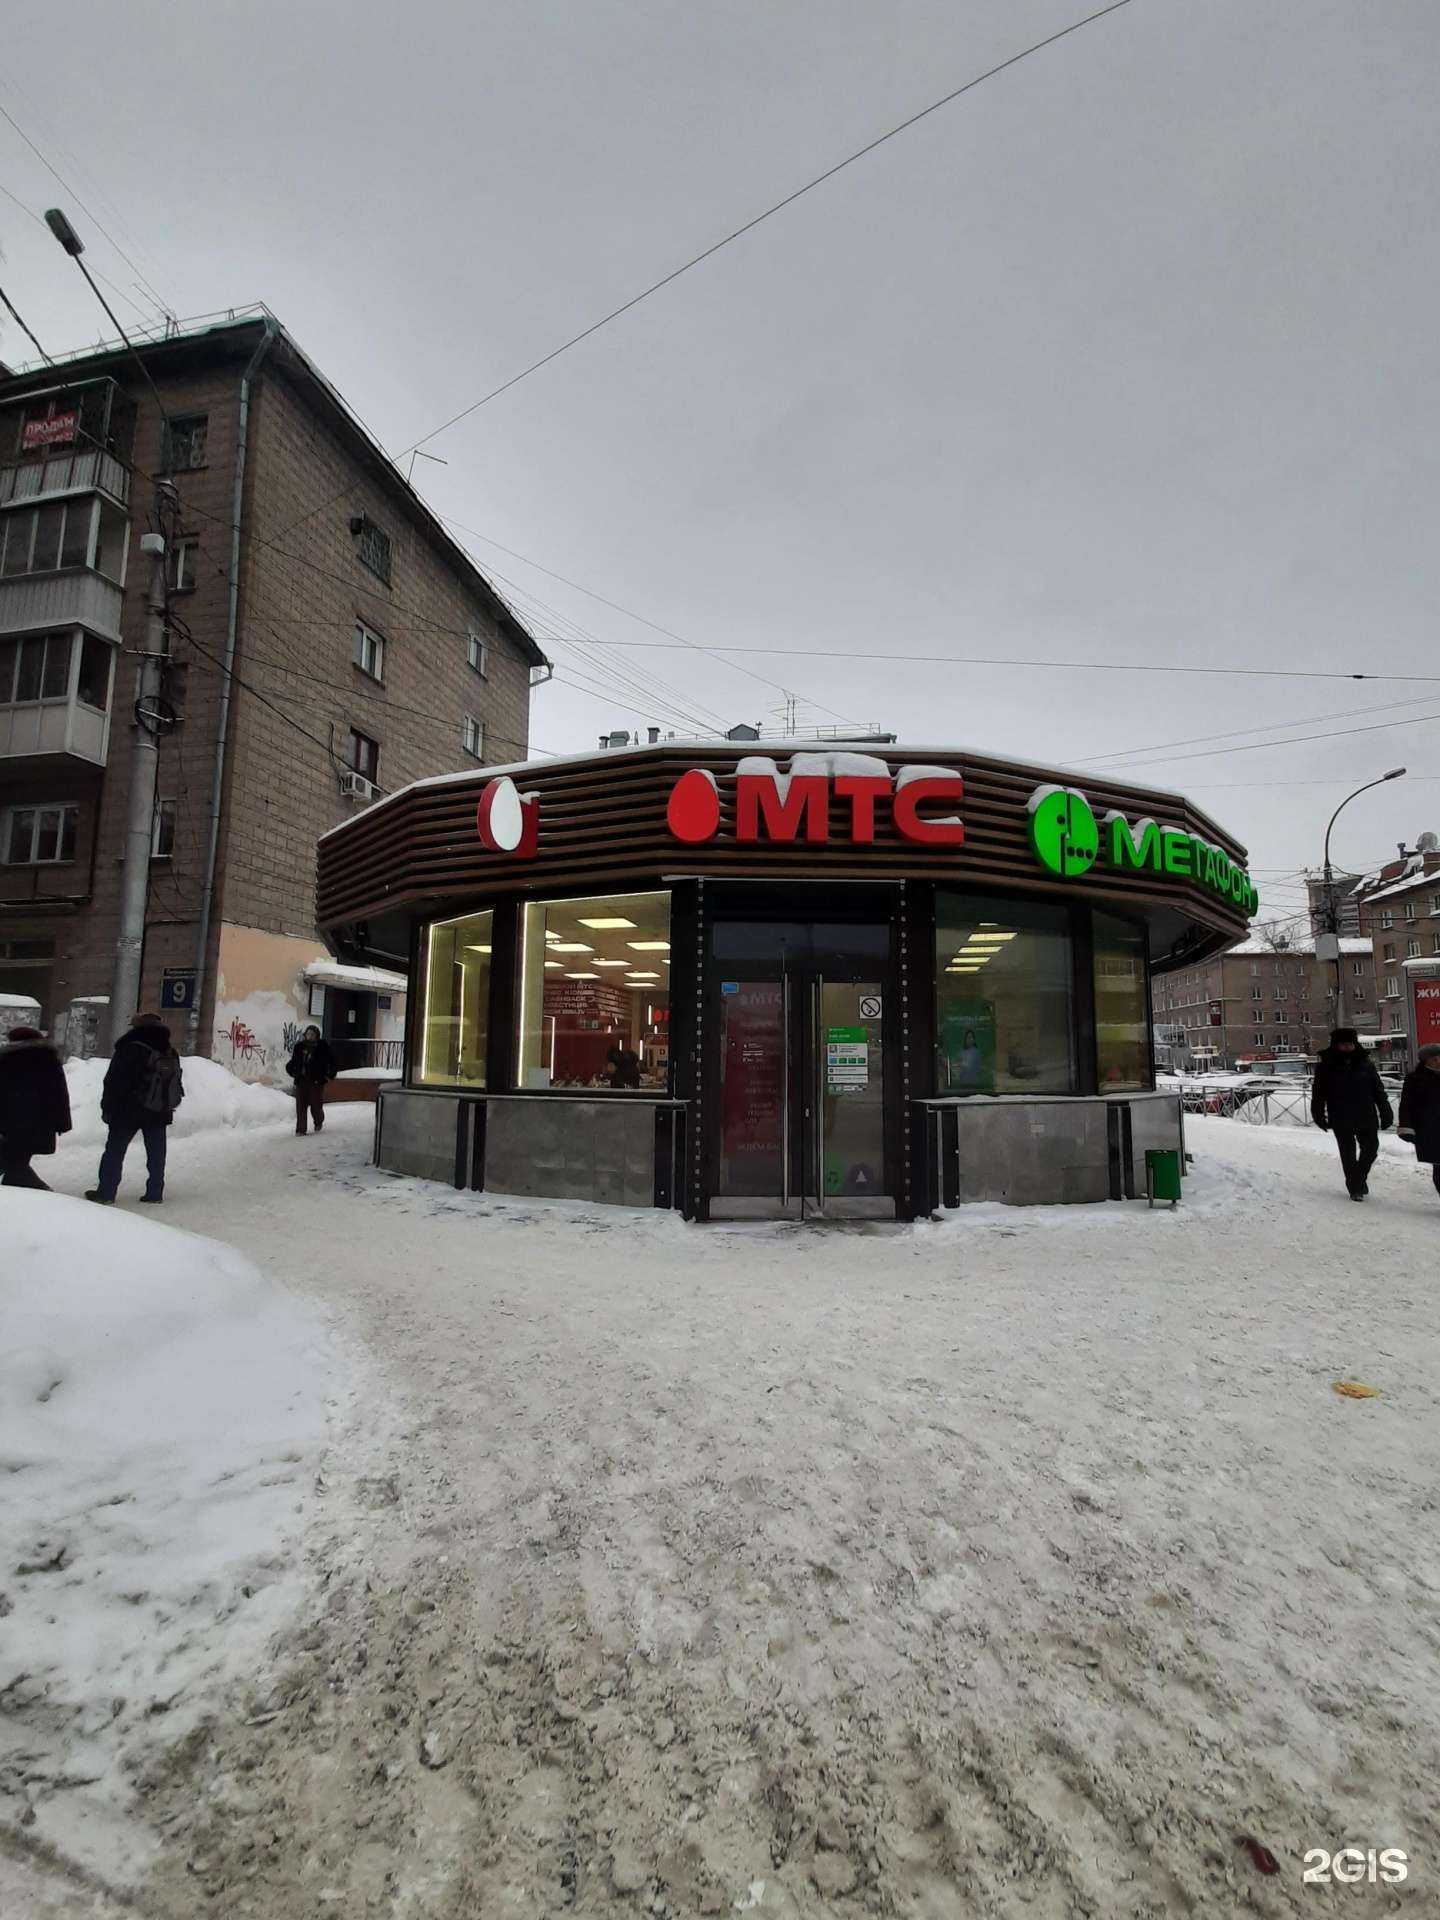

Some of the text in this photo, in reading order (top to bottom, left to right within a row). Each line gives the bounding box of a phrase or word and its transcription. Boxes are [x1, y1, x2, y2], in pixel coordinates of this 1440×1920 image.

[736, 773, 965, 847] МТС
[1107, 814, 1259, 918] МЕГАФОН
[172, 981, 186, 1003] 9
